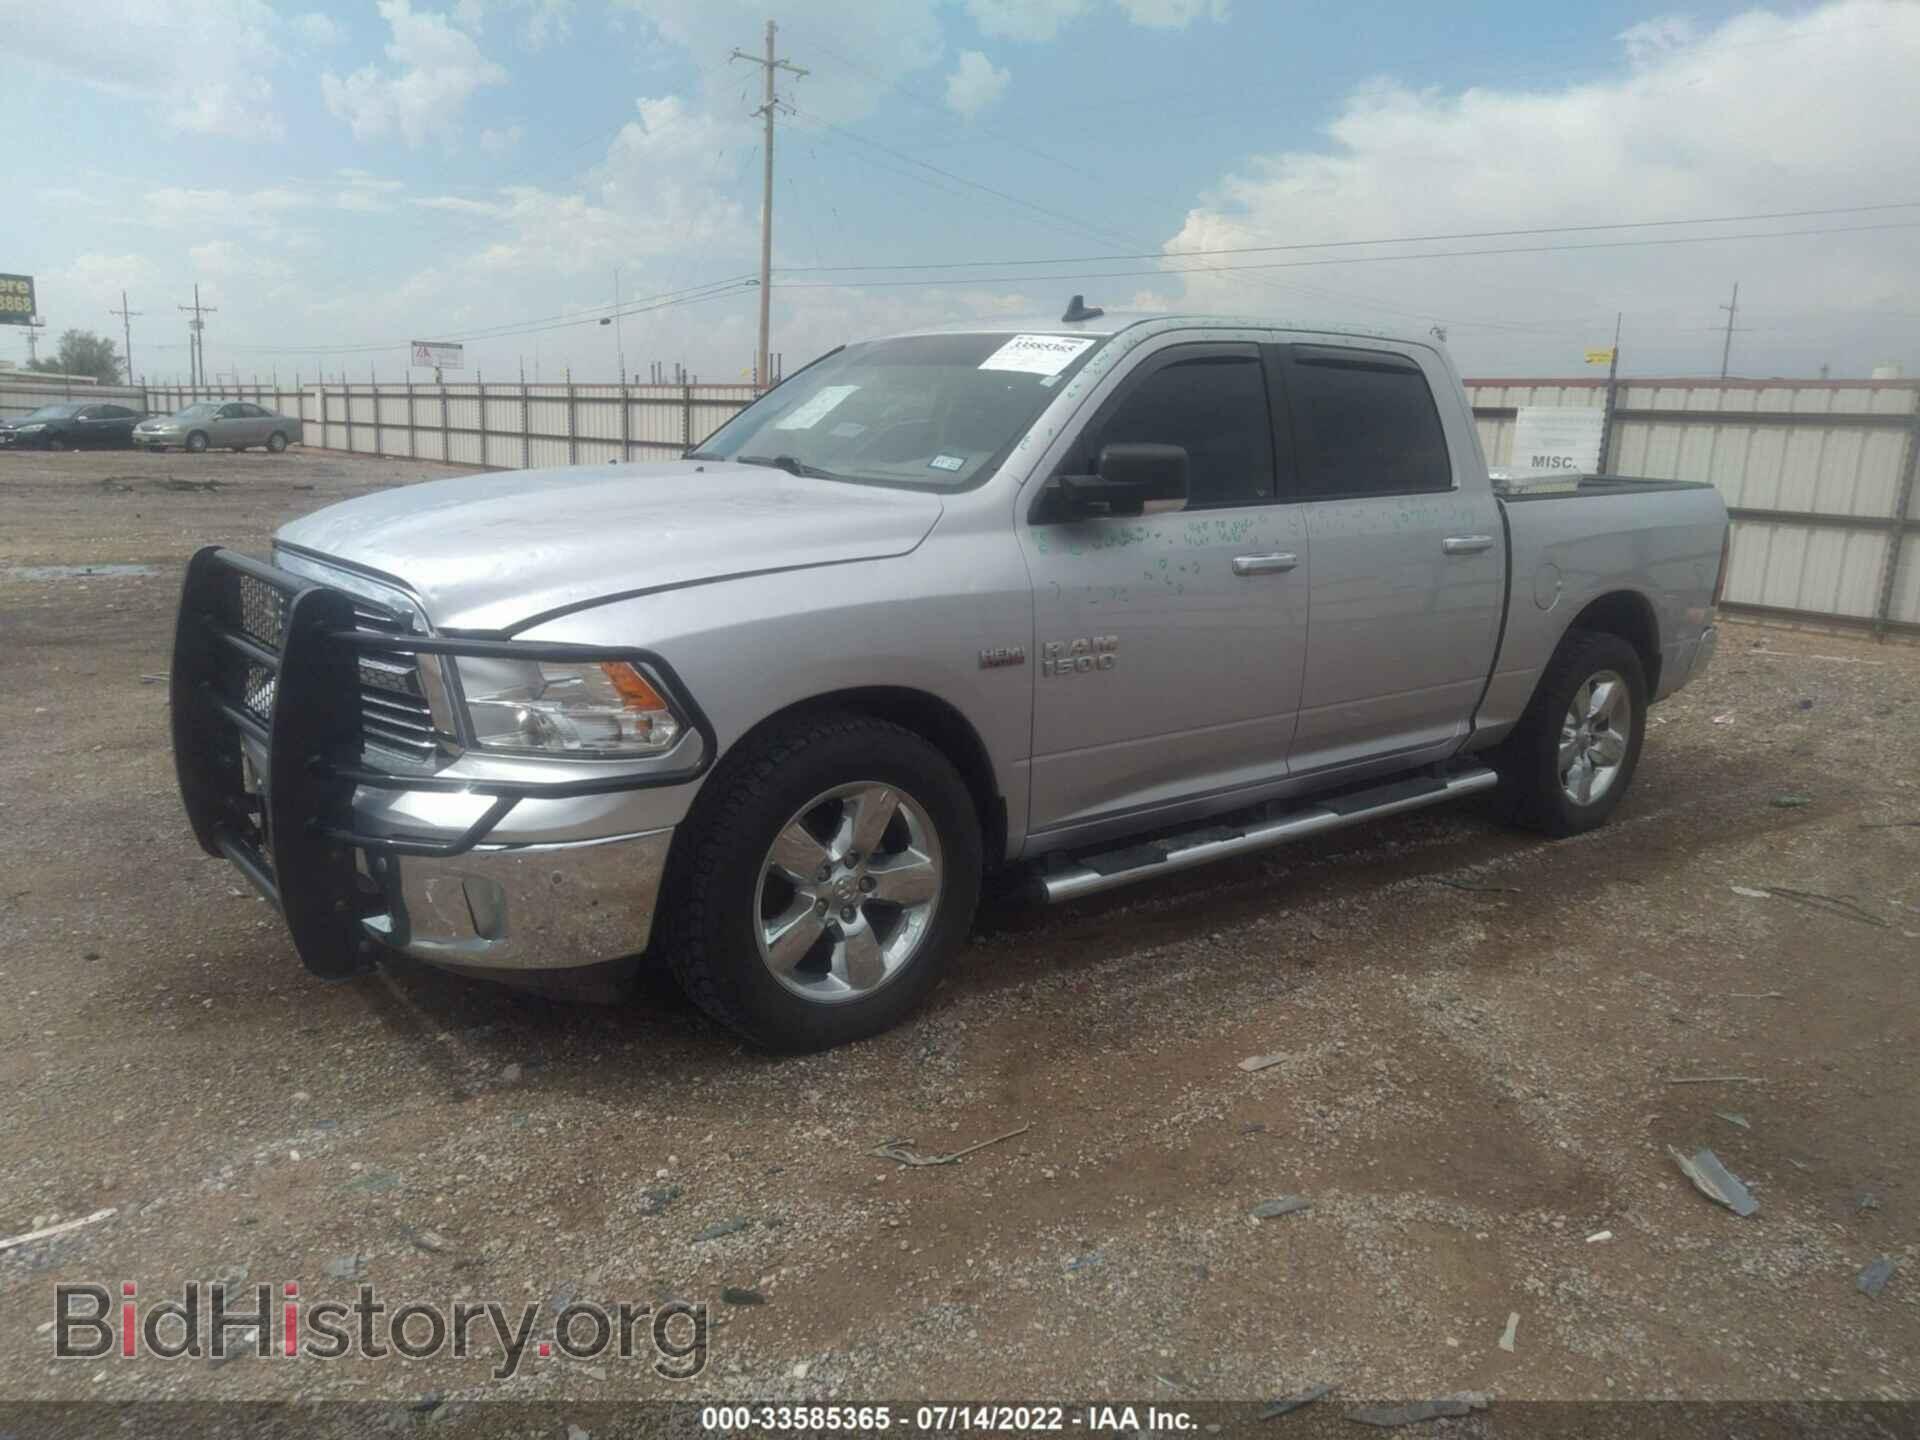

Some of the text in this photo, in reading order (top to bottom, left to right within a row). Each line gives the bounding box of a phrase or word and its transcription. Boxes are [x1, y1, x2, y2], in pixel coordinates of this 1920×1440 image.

[1531, 455, 1577, 469] MISC.
[1042, 634, 1121, 658] RAM
[1041, 654, 1117, 678] 1500
